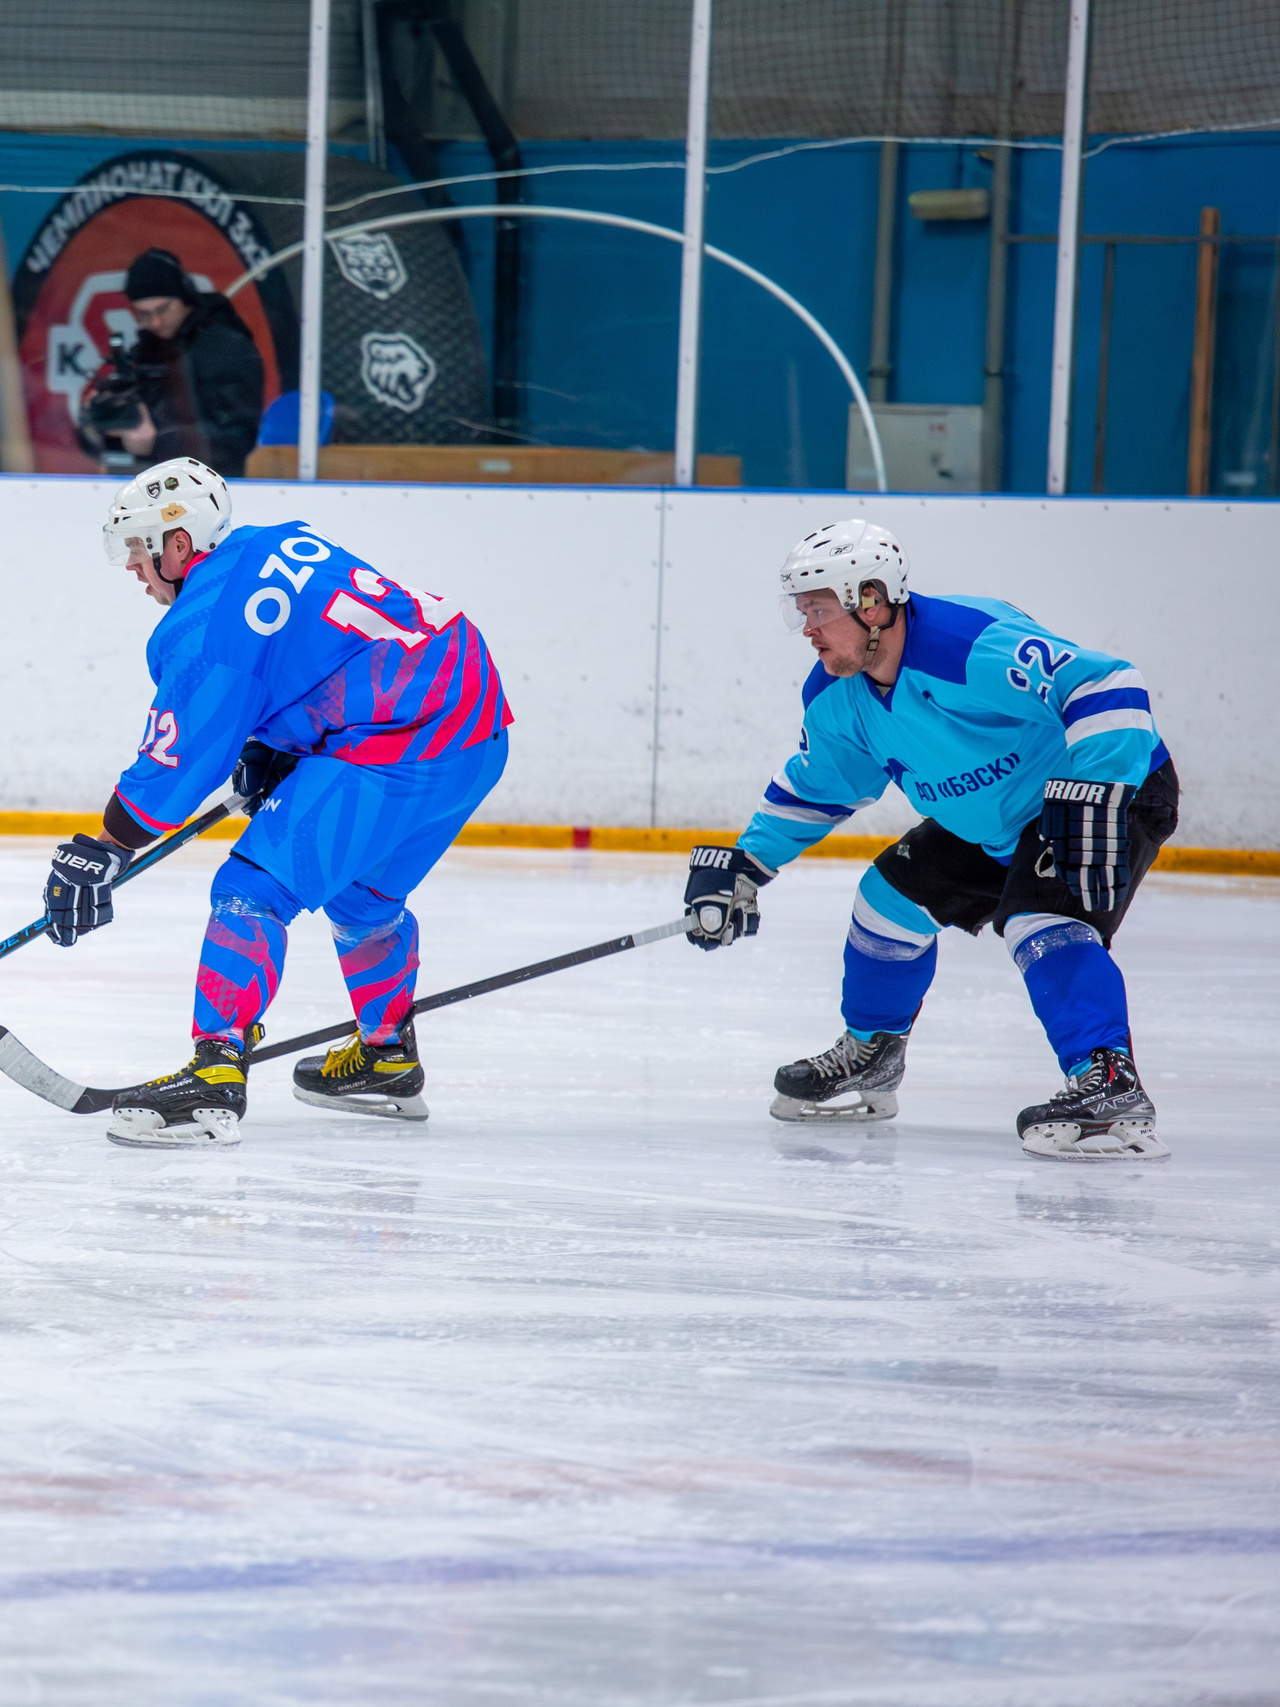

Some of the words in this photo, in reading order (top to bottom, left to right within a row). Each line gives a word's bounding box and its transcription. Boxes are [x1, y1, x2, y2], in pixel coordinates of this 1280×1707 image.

[320, 566, 464, 657] 12
[138, 707, 180, 769] 12
[914, 780, 938, 803] АО
[937, 752, 1021, 799] «БЭСК»
[1044, 780, 1106, 804] RRIOR
[52, 849, 105, 875] AUER
[690, 847, 732, 870] RIOR
